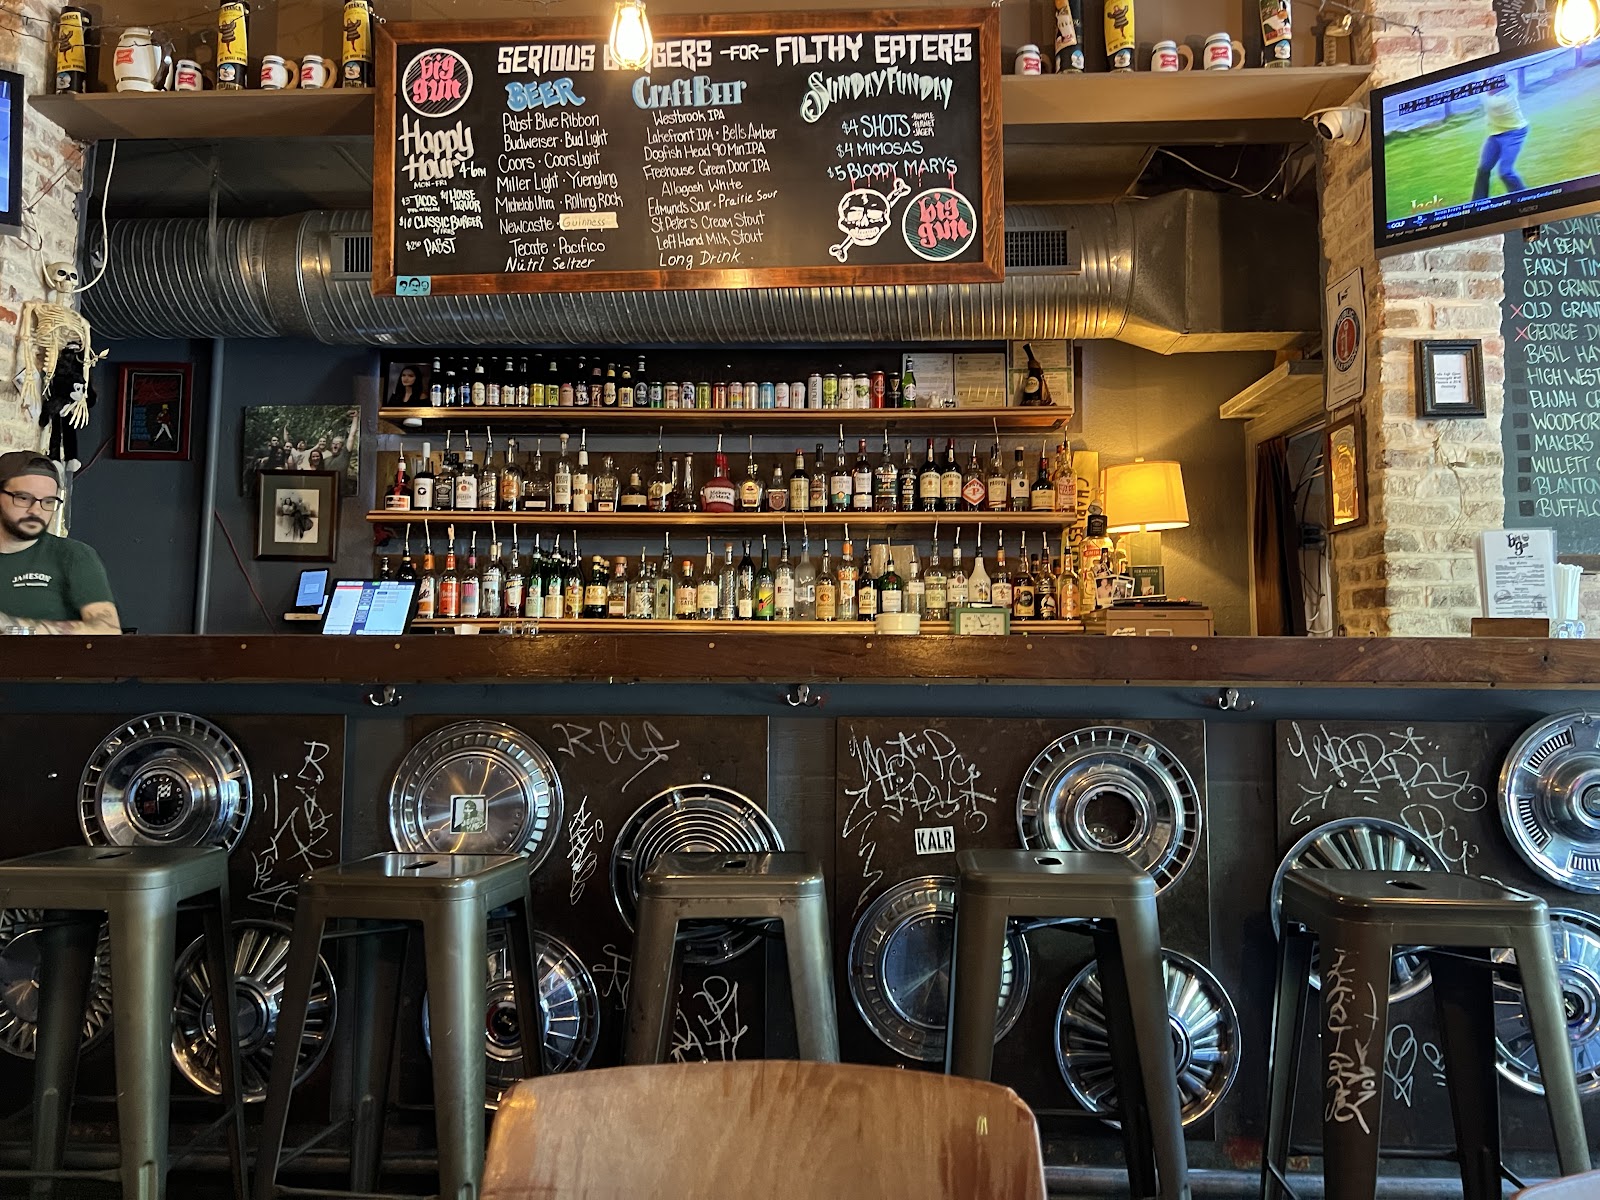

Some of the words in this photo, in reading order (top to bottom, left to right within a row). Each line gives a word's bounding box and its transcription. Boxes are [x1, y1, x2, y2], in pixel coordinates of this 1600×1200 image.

[497, 44, 595, 76] SERIOUS
[603, 39, 712, 74] BGERS
[776, 33, 864, 66] FILTHY
[874, 33, 972, 65] EATERS
[505, 77, 585, 112] BEER
[503, 112, 533, 133] Pabst
[535, 112, 559, 131] Blue
[652, 109, 707, 126] Westbrook
[707, 108, 725, 121] IPA
[841, 119, 859, 136] $4
[860, 113, 911, 138] SHOTS
[398, 113, 475, 161] Happy
[504, 133, 560, 152] Budweiser
[565, 131, 588, 148] Bud
[588, 129, 609, 148] Light
[646, 127, 695, 144] Lakefront
[696, 128, 714, 141] IPA
[722, 123, 747, 141] Bells
[748, 122, 778, 140] Amber
[644, 144, 683, 163] Dogfish
[684, 143, 711, 159] Head
[712, 142, 727, 157] 90
[745, 141, 766, 155] IPA
[836, 142, 854, 158] $4
[857, 140, 924, 157] MIMOSAS
[401, 154, 460, 182] Hour
[498, 154, 536, 174] Coors
[544, 154, 577, 172] Coors
[576, 151, 601, 170] Light
[642, 164, 696, 181] Freehouse
[698, 159, 727, 177] Green
[726, 159, 750, 174] Door
[751, 158, 771, 174] IPA
[827, 164, 846, 181] $5
[846, 161, 899, 181] BLOODY
[413, 180, 448, 190] MON-FRI
[497, 175, 533, 193] Miller
[534, 173, 559, 193] Light
[566, 170, 618, 193] Yuengling
[661, 180, 704, 197] Allagash
[708, 178, 744, 193] White
[401, 196, 411, 206] $3
[409, 194, 439, 208] TACOS
[449, 188, 476, 204] HOUSE
[452, 199, 482, 213] LIQUOR
[495, 195, 535, 214] Michelob
[534, 194, 555, 212] Ultra
[565, 193, 598, 213] Rolling
[597, 192, 624, 209] Rock
[689, 196, 712, 213] Sour
[719, 193, 754, 209] Prairie
[757, 189, 778, 201] Sour
[917, 193, 959, 220] big
[399, 216, 412, 230] $10
[414, 215, 451, 230] CLASSIC
[450, 215, 484, 231] BURGER
[500, 218, 554, 234] Newcastle
[562, 216, 606, 228] Guinness
[701, 215, 733, 229] Cream
[733, 209, 766, 227] Stout
[656, 233, 677, 251] Left
[677, 232, 704, 248] Hand
[706, 233, 731, 247] Milk
[731, 228, 764, 245] Stout
[917, 218, 972, 248] gun
[423, 236, 457, 258] PABST
[509, 239, 549, 257] Tecate
[558, 239, 606, 255] Pacifico
[1524, 238, 1552, 256] JIM
[1553, 237, 1596, 255] BEAM
[552, 257, 596, 270] Seltzer
[660, 252, 694, 270] Long
[700, 247, 741, 266] Drink
[1523, 257, 1568, 277] EARLY
[1523, 279, 1553, 297] OLD
[1522, 301, 1552, 319] OLD
[1528, 322, 1578, 341] GEORGE
[1524, 343, 1570, 364] BASIL
[1526, 367, 1563, 386] HIGH
[1529, 389, 1577, 408] ELIJAH
[1534, 433, 1594, 452] MAKERS
[1531, 455, 1590, 475] WILLETT
[12, 572, 52, 583] JAMESON
[917, 829, 954, 852] KALR
